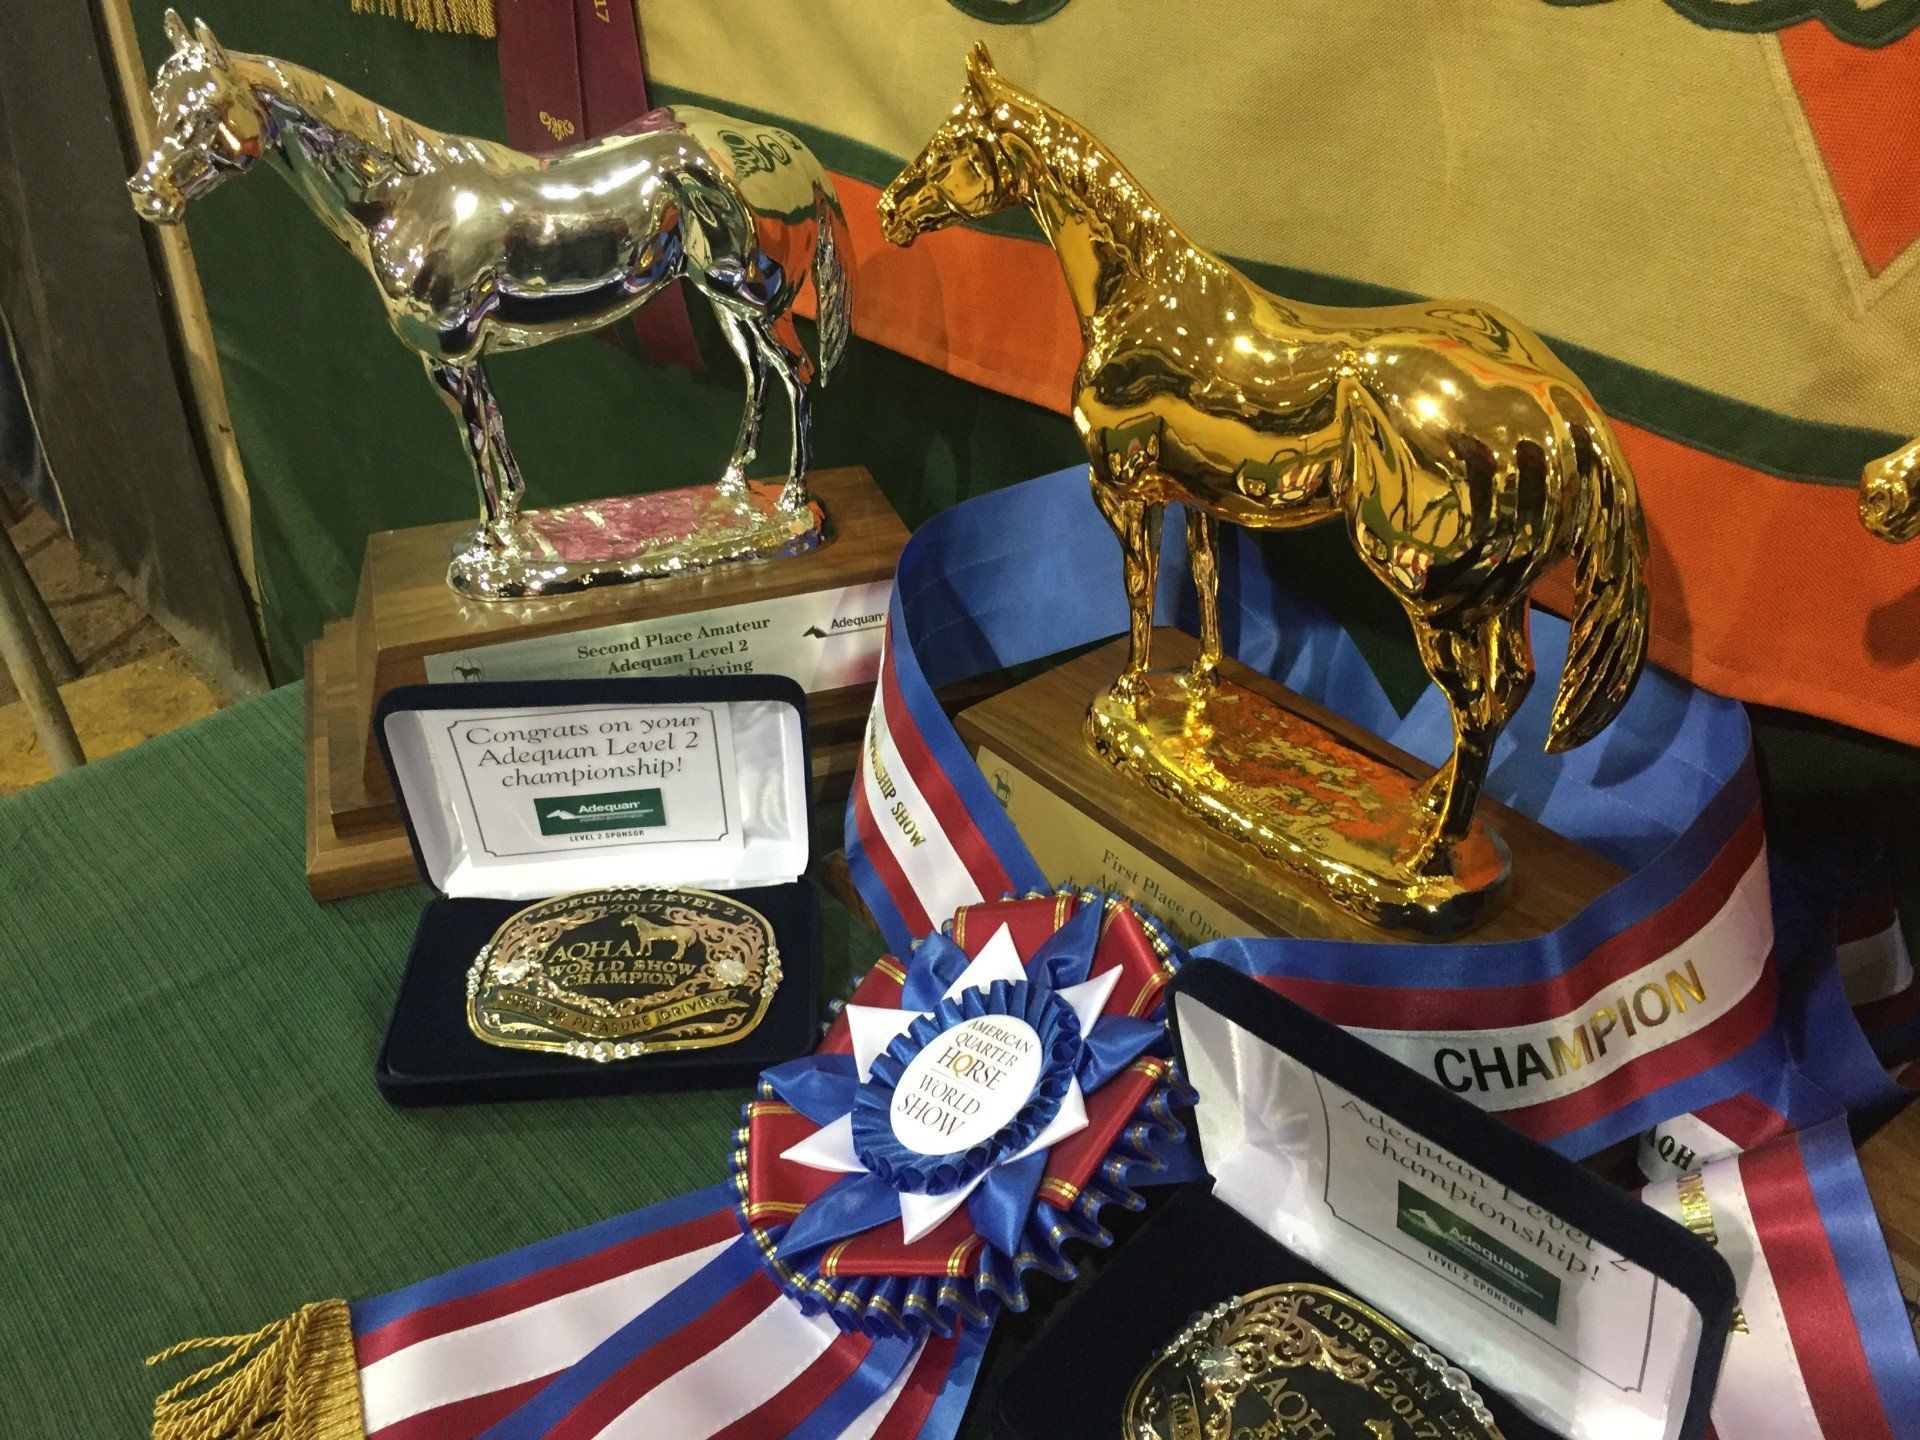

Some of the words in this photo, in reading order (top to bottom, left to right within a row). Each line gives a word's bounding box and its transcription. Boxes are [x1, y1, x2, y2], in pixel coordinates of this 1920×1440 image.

[577, 637, 641, 660] Second
[645, 632, 693, 648] Place
[697, 617, 771, 640] Amateur
[831, 612, 883, 630] Adequan
[608, 652, 684, 675] Adequan
[687, 641, 735, 661] Level
[738, 639, 749, 652] 2
[466, 720, 589, 745] Congrats
[599, 720, 631, 735] on
[640, 716, 701, 735] your
[478, 743, 598, 767] Adequan
[605, 732, 675, 756] Level
[684, 731, 699, 749] 2
[501, 757, 683, 787] championship!
[578, 802, 639, 814] Adequan
[891, 801, 926, 847] SHOW
[570, 834, 595, 842] LEVEL
[605, 830, 645, 839] SPONSOR
[535, 893, 642, 919] ADEQUAN
[651, 893, 718, 911] LEVEL
[723, 906, 737, 916] 2
[609, 904, 664, 915] 2017
[1102, 849, 1139, 885] First
[1142, 876, 1185, 916] Place
[1189, 910, 1227, 941] Ope
[548, 940, 634, 964] AQHA
[549, 959, 626, 977] WORLD
[632, 959, 698, 976] SHOW
[561, 972, 679, 987] CHAMPION
[573, 1014, 651, 1034] PLEASURE
[657, 995, 729, 1021] DRIVING
[1433, 958, 1707, 1093] CHAMPION
[955, 1031, 1019, 1067] QUARTER
[967, 1020, 1034, 1054] AMERICAN
[919, 1073, 981, 1115] WORLD
[897, 1093, 966, 1137] SHOW
[1341, 1100, 1488, 1190] Adequan
[1365, 1134, 1600, 1282] championship!
[1472, 1279, 1524, 1316] SPONSOR
[1313, 1303, 1441, 1401] ADEQUAN
[1373, 1378, 1442, 1439] 2017
